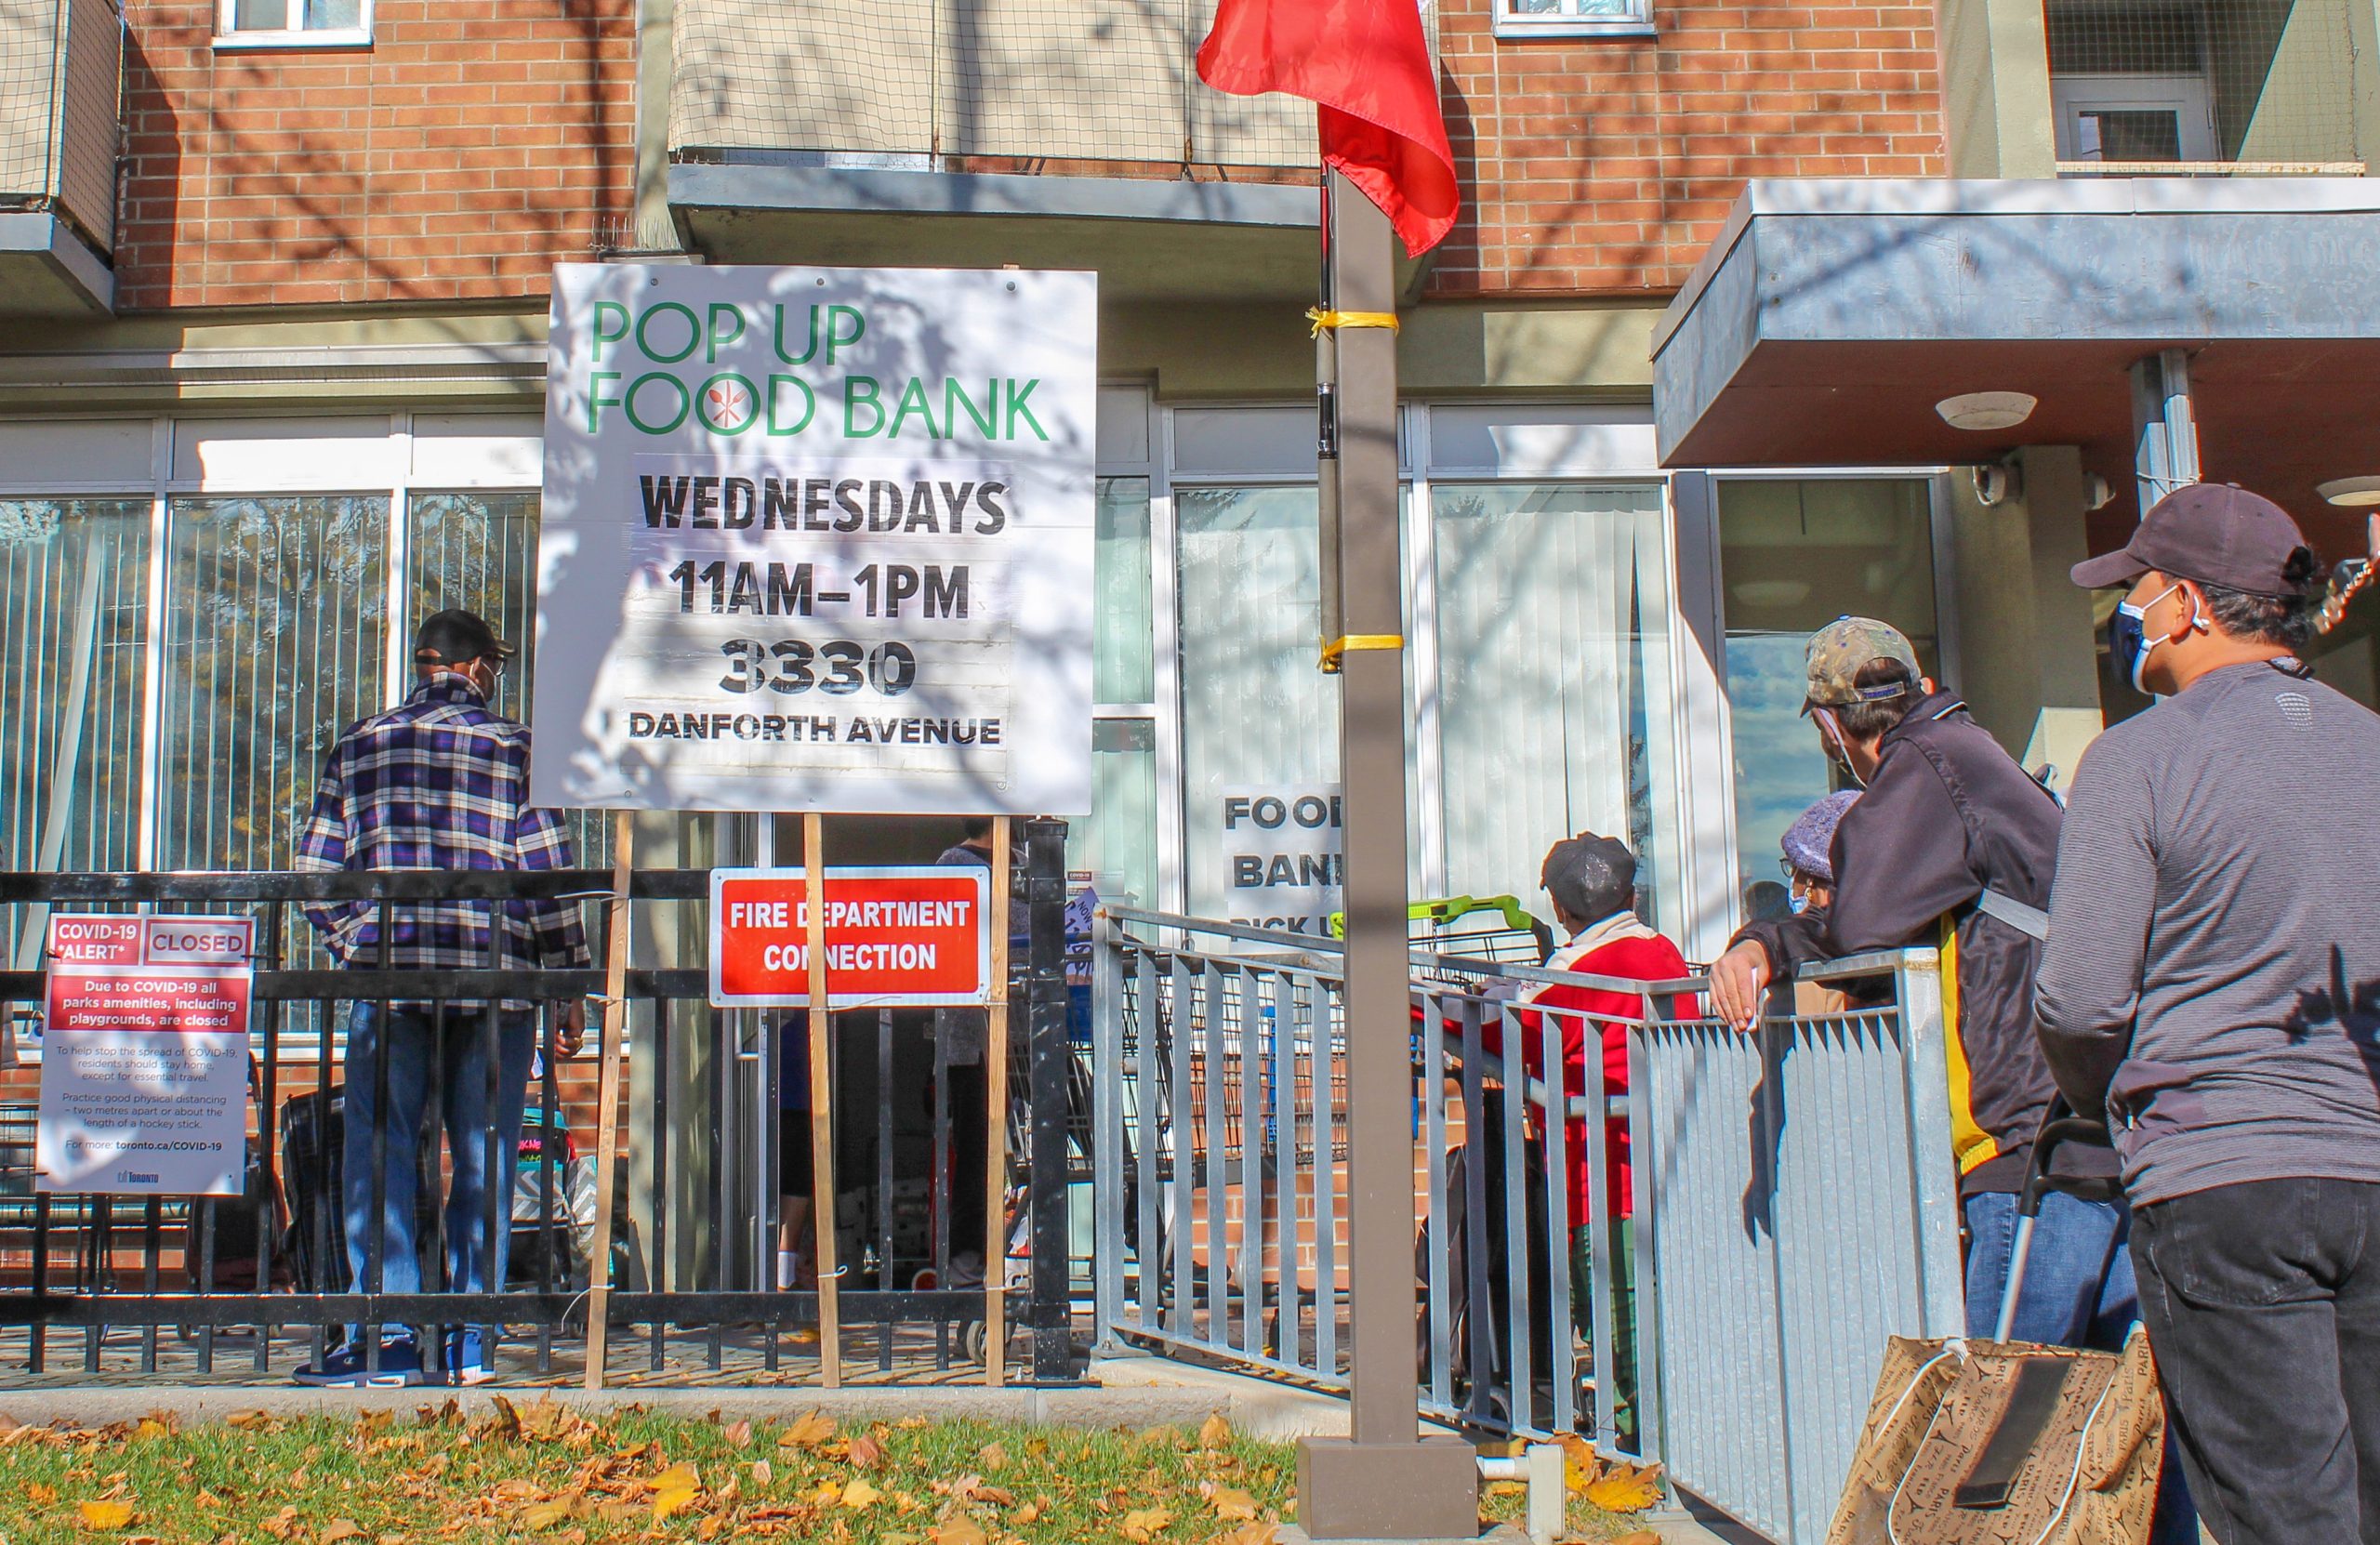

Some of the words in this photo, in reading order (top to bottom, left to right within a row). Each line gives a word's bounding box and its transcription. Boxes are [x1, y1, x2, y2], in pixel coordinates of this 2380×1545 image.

[591, 300, 747, 365] POP
[774, 303, 866, 366] UP
[588, 372, 817, 437] FOOD
[844, 376, 1050, 442] BANK
[640, 474, 1007, 535] WEDNESDAYS
[720, 640, 916, 696] 3330
[628, 711, 836, 743] DANFORTH
[846, 716, 1000, 745] AVENUE
[1234, 853, 1342, 888] BAN
[731, 902, 787, 928] FIRE
[59, 924, 137, 940] COVID-19
[152, 934, 243, 952] CLOSED
[85, 981, 111, 992] Due
[115, 982, 129, 993] to
[134, 982, 197, 994] COVID-19
[201, 983, 217, 994] all
[63, 997, 99, 1010] parks
[103, 997, 171, 1010] amenities,
[176, 998, 237, 1012] including
[69, 1013, 155, 1027] playgrounds,
[159, 1017, 181, 1025] are
[185, 1014, 228, 1026] closed
[57, 1047, 69, 1055] To
[71, 1047, 92, 1057] help
[95, 1047, 116, 1057] stop
[119, 1047, 136, 1056] the
[139, 1048, 172, 1058] spread
[175, 1048, 187, 1057] of
[78, 1059, 122, 1069] residents
[125, 1060, 158, 1069] should
[160, 1061, 181, 1071] stay
[82, 1072, 114, 1083] except
[117, 1072, 132, 1080] for
[134, 1072, 177, 1082] essential
[62, 1093, 102, 1102] Practice
[104, 1094, 131, 1103] good
[133, 1095, 173, 1104] physical
[176, 1095, 227, 1105] distancing
[73, 1107, 93, 1116] two
[96, 1107, 129, 1116] metres
[132, 1108, 158, 1117] apart
[175, 1107, 205, 1116] about
[206, 1107, 223, 1116] the
[84, 1119, 115, 1129] length
[118, 1119, 128, 1128] of
[139, 1119, 175, 1130] hockey
[65, 1141, 83, 1149] For
[116, 1141, 222, 1151] toronto.ca/COVID-19
[2136, 1337, 2149, 1376] PARIS
[1995, 1356, 2008, 1386] ARIS
[2122, 1367, 2135, 1402] Paris
[2117, 1420, 2129, 1451] PARIS
[2016, 1463, 2035, 1500] PARIS
[1924, 1487, 1950, 1519] PARIS
